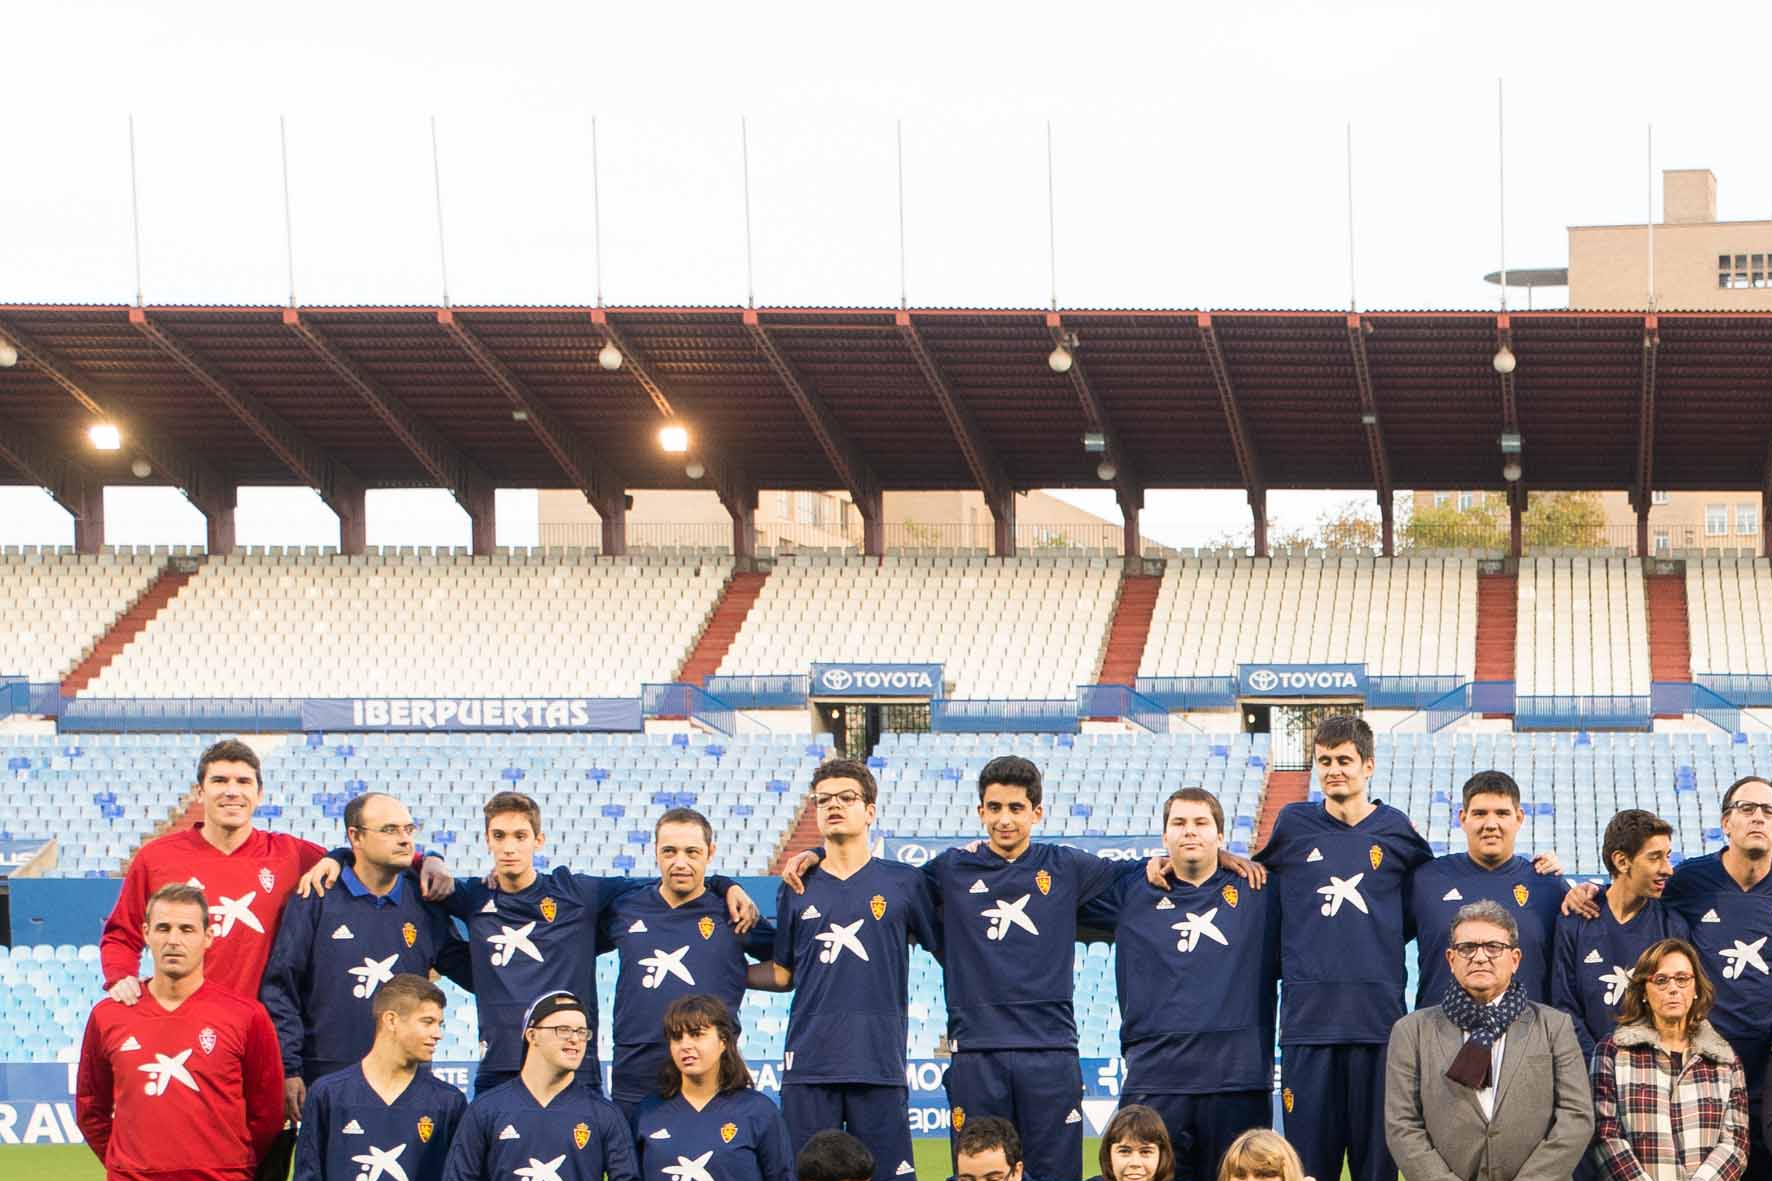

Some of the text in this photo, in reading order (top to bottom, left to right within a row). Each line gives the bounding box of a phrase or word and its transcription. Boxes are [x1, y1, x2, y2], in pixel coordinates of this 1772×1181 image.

[852, 671, 933, 689] TOYOTA
[1277, 671, 1358, 689] TOYOTA
[352, 699, 590, 729] IBERPUERTAS
[1093, 847, 1172, 862] EXUS
